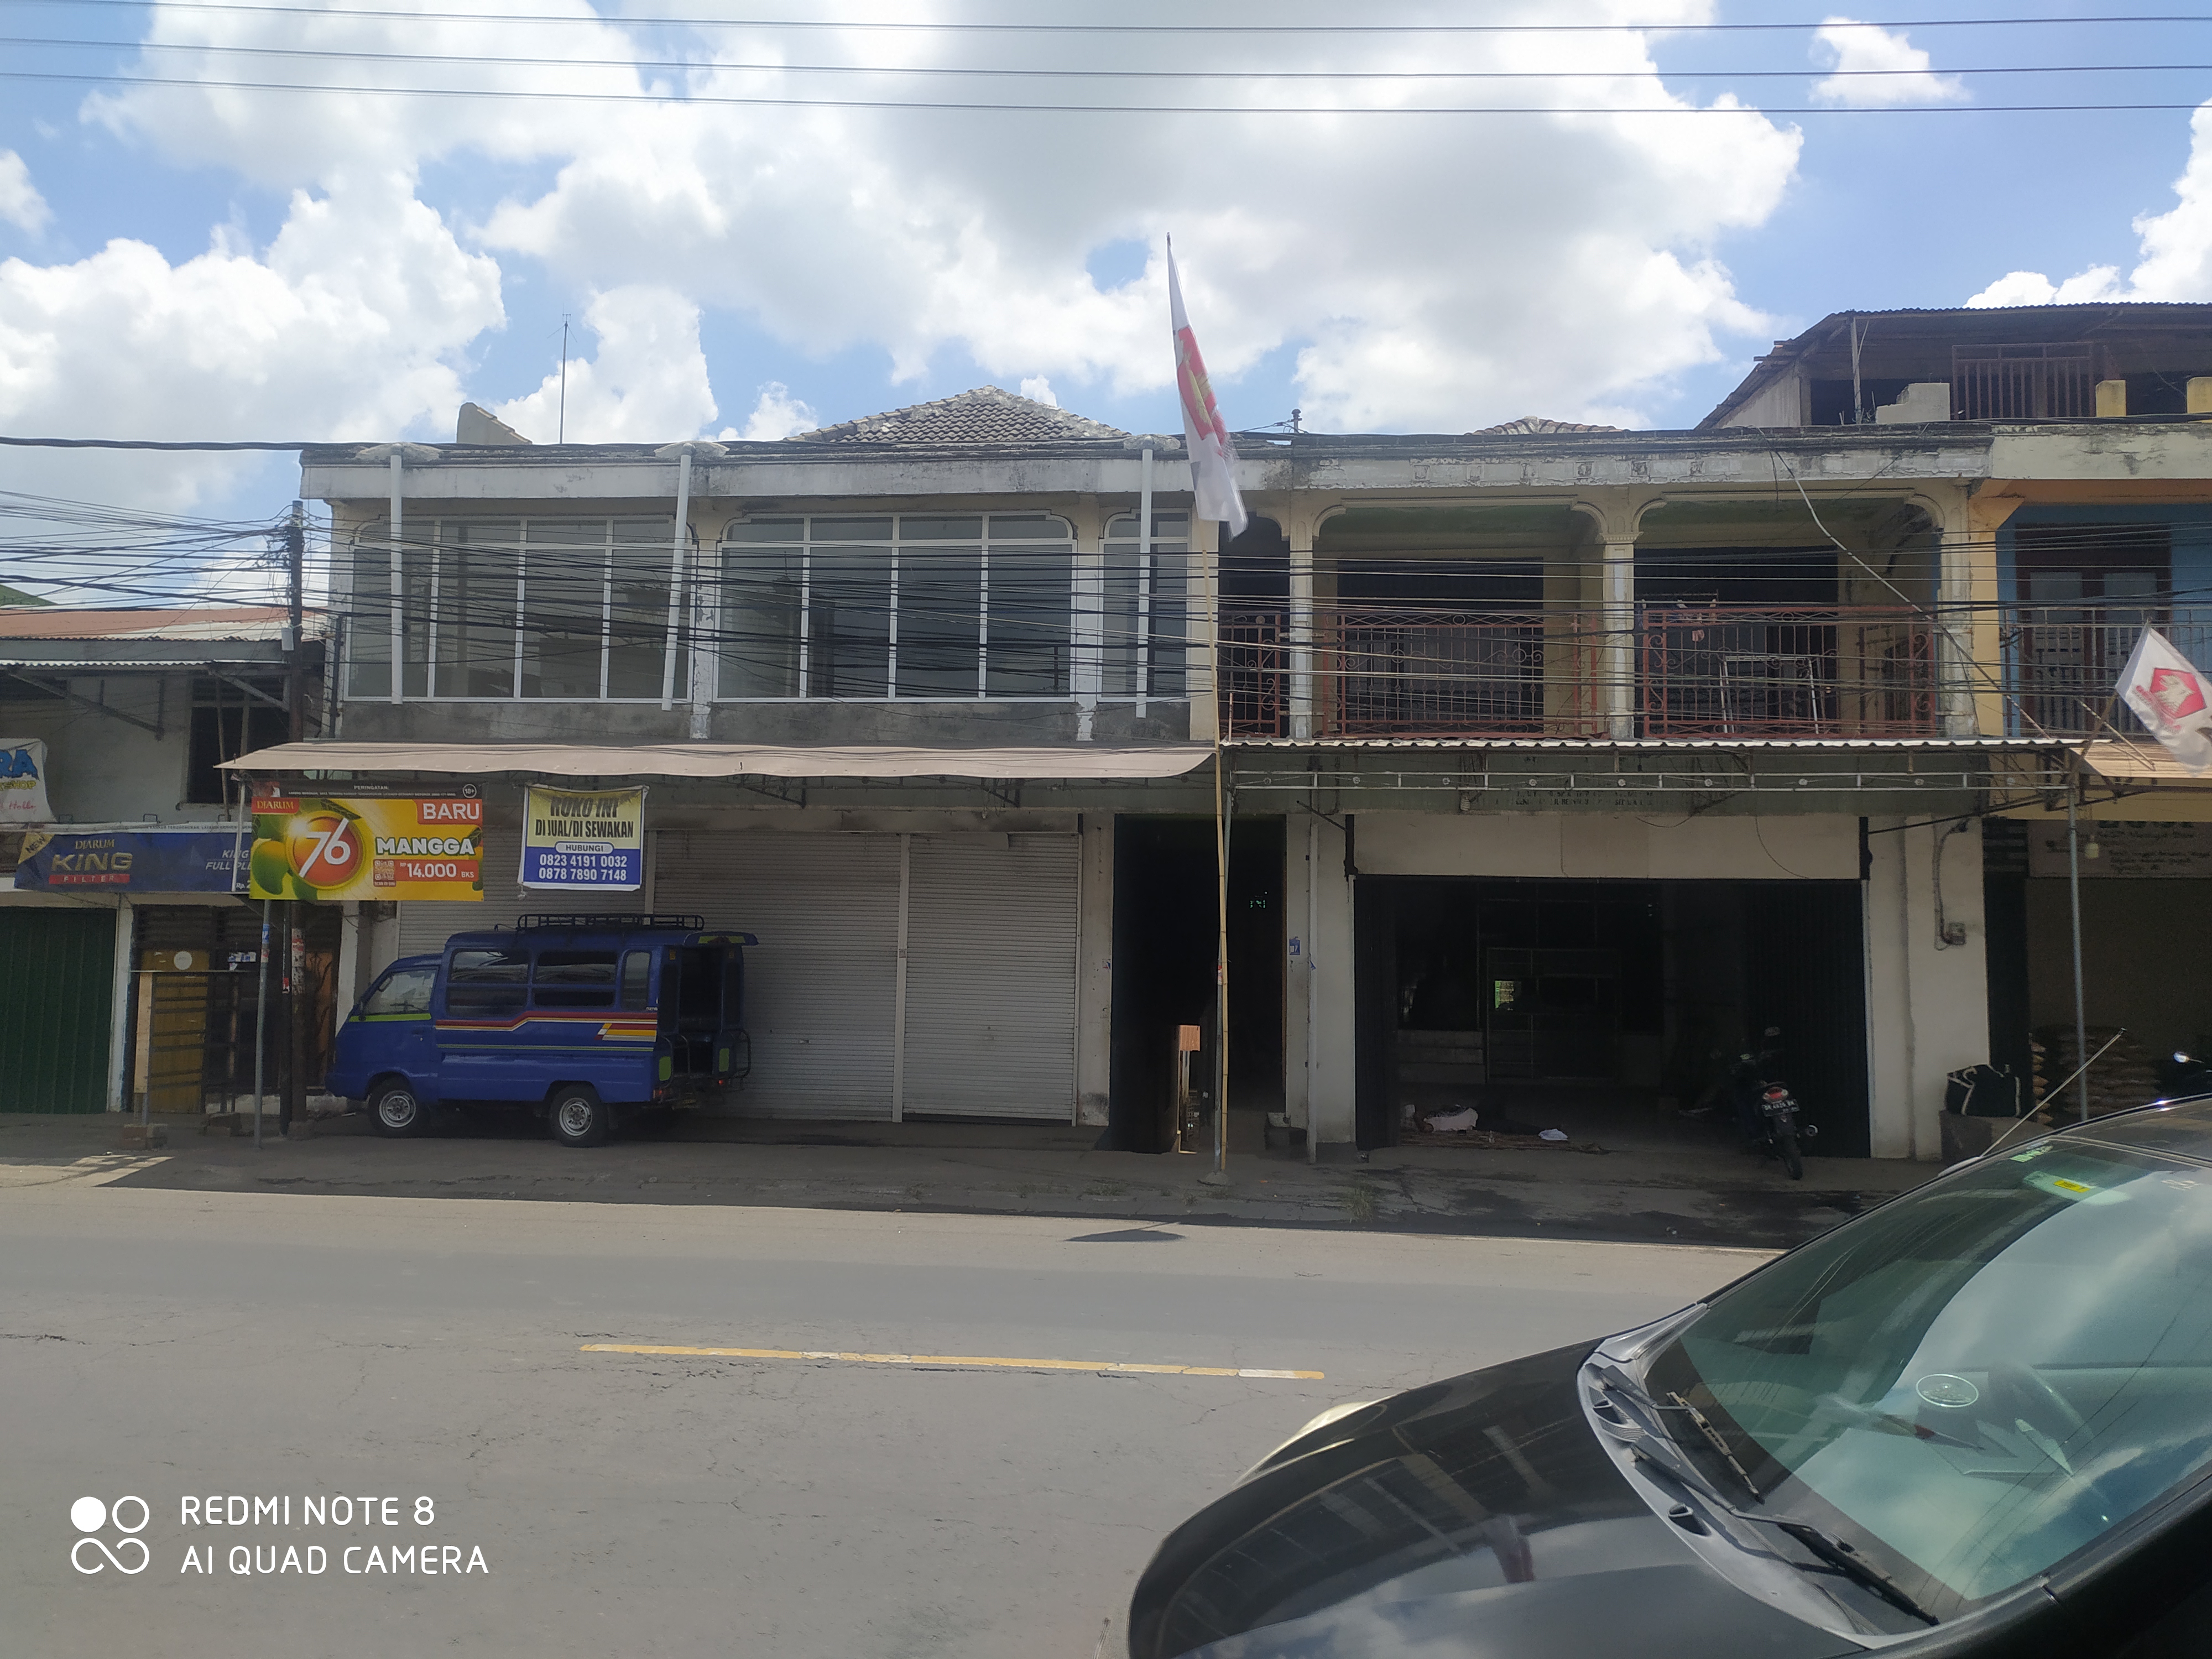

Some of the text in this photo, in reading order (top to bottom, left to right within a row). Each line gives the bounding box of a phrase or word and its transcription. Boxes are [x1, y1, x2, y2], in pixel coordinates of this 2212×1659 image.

[257, 800, 294, 810] DJARUM
[422, 803, 480, 820] BARU
[595, 797, 619, 818] INI
[585, 820, 634, 838] SEWAKAN
[25, 835, 46, 854] NEW
[298, 817, 351, 878] 76
[376, 837, 475, 855] MANGGA
[51, 852, 133, 872] KING
[205, 861, 231, 870] FULL
[539, 854, 627, 868] 0823 4191 0032
[63, 875, 114, 883] FILTER
[407, 863, 457, 878] 14.000
[539, 867, 627, 881] 0878 7890 7148
